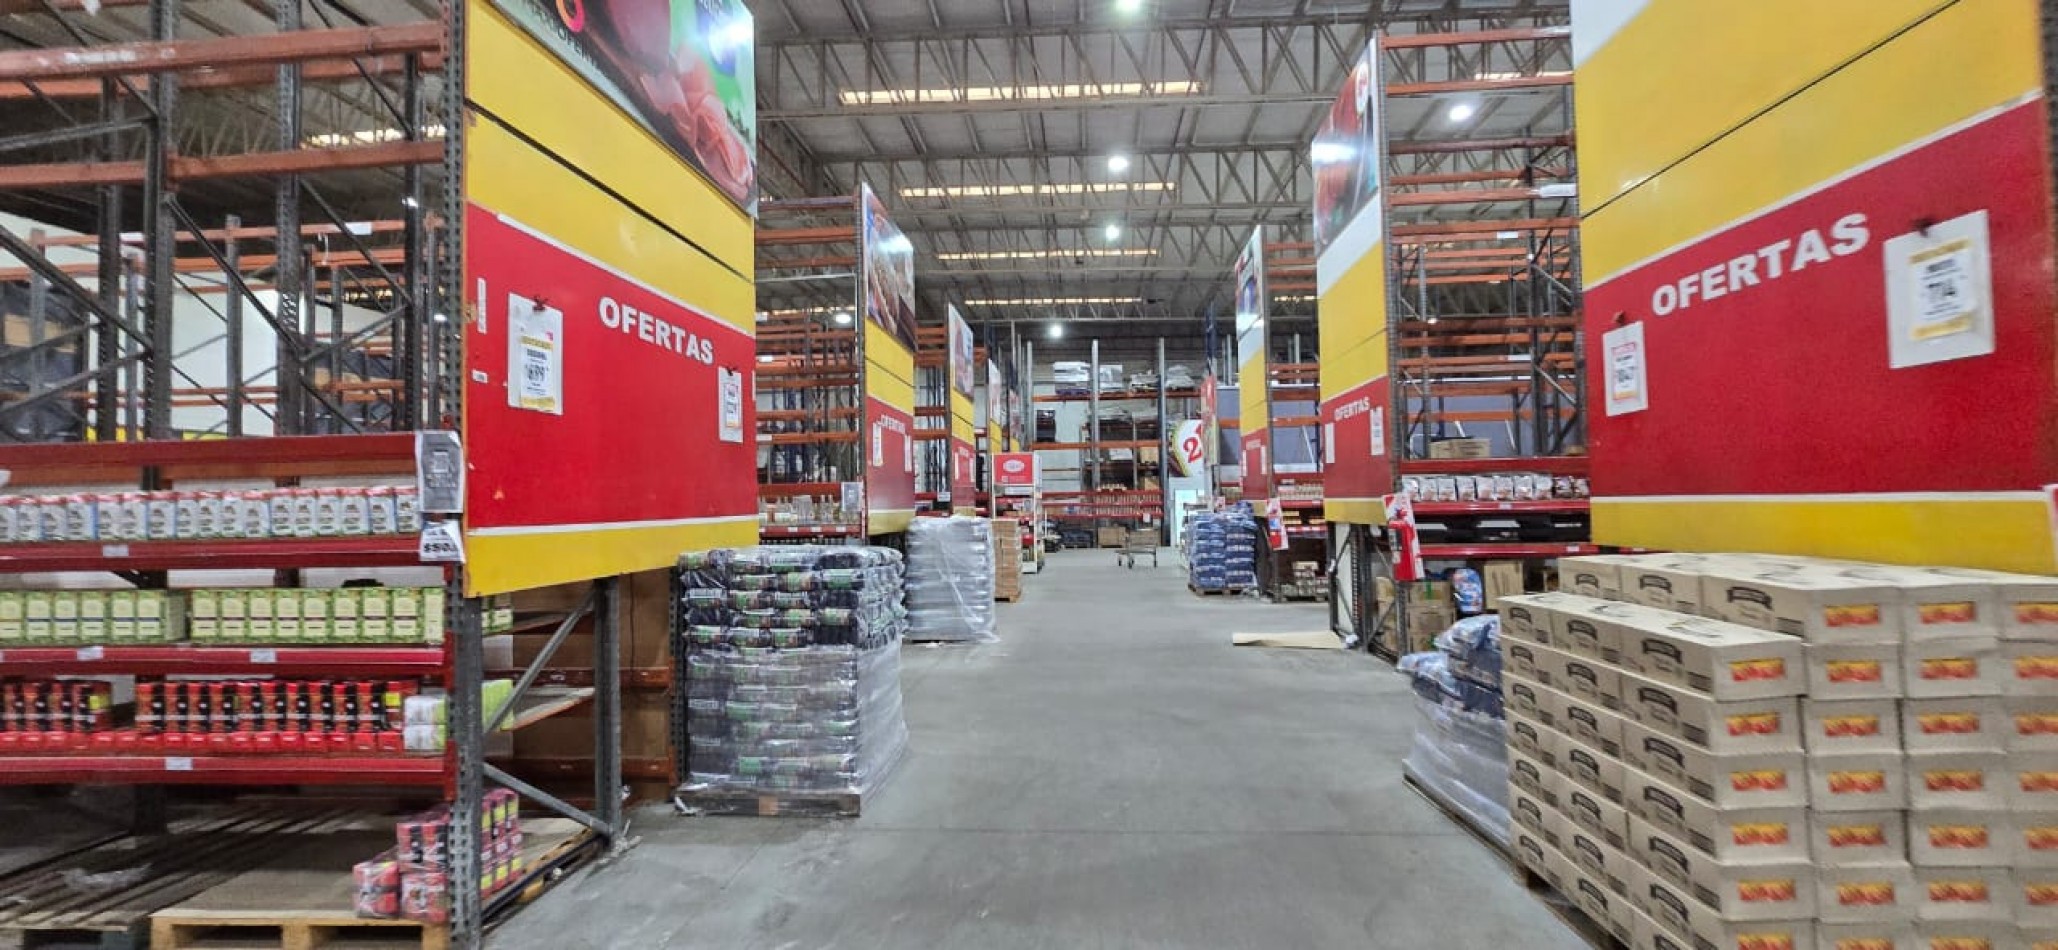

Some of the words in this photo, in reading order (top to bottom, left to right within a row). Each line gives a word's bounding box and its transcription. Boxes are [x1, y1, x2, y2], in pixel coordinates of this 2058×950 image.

[1652, 213, 1870, 316] OFERTAS
[598, 297, 714, 365] OFERTAS
[1334, 397, 1370, 421] OFERTAS
